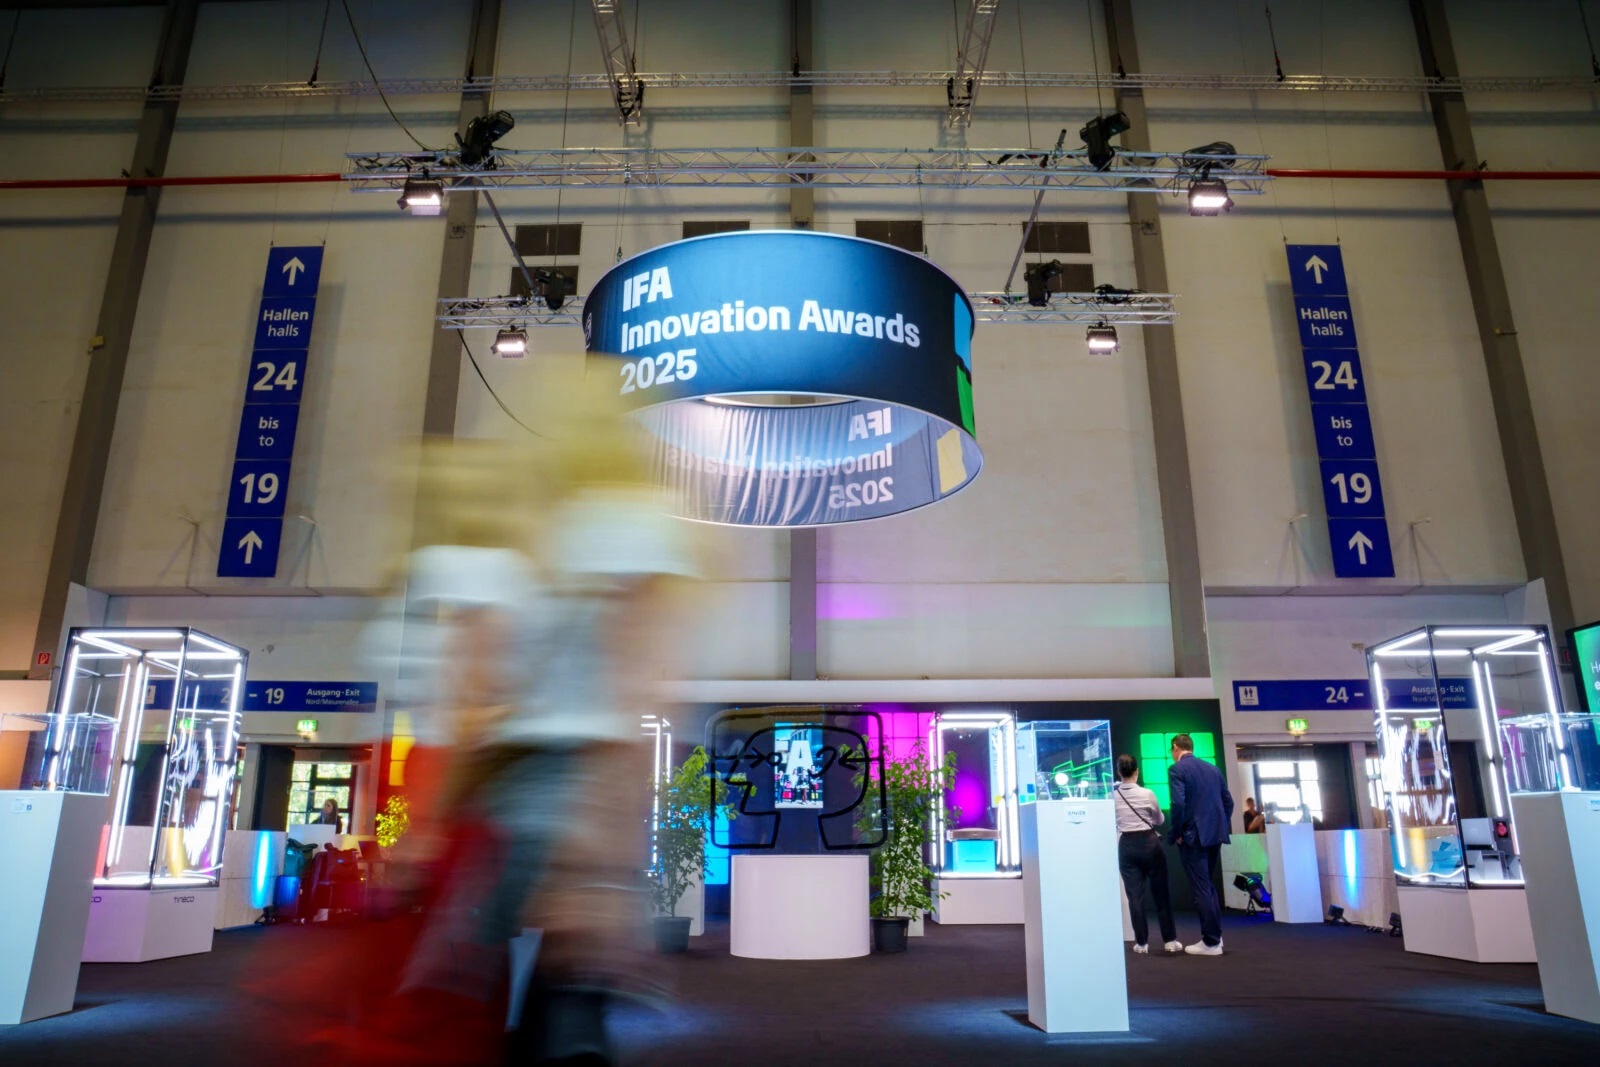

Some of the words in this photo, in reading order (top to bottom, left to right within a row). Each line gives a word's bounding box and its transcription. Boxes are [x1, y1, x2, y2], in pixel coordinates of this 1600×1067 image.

[622, 266, 673, 312] IFA
[263, 309, 309, 322] Hallen
[1301, 308, 1348, 321] Hallen
[267, 324, 299, 337] halls
[621, 300, 791, 354] Innovation
[798, 299, 921, 349] Awards
[1311, 323, 1344, 337] halls
[252, 362, 298, 391] 24
[619, 348, 698, 395] 2025
[1311, 360, 1358, 390] 24
[258, 416, 279, 430] bis
[1330, 416, 1353, 430] bis
[258, 435, 274, 447] to
[1336, 434, 1353, 447] to
[240, 473, 279, 504] 19
[1330, 473, 1372, 504] 19
[264, 687, 285, 705] 19
[1324, 686, 1349, 704] 24
